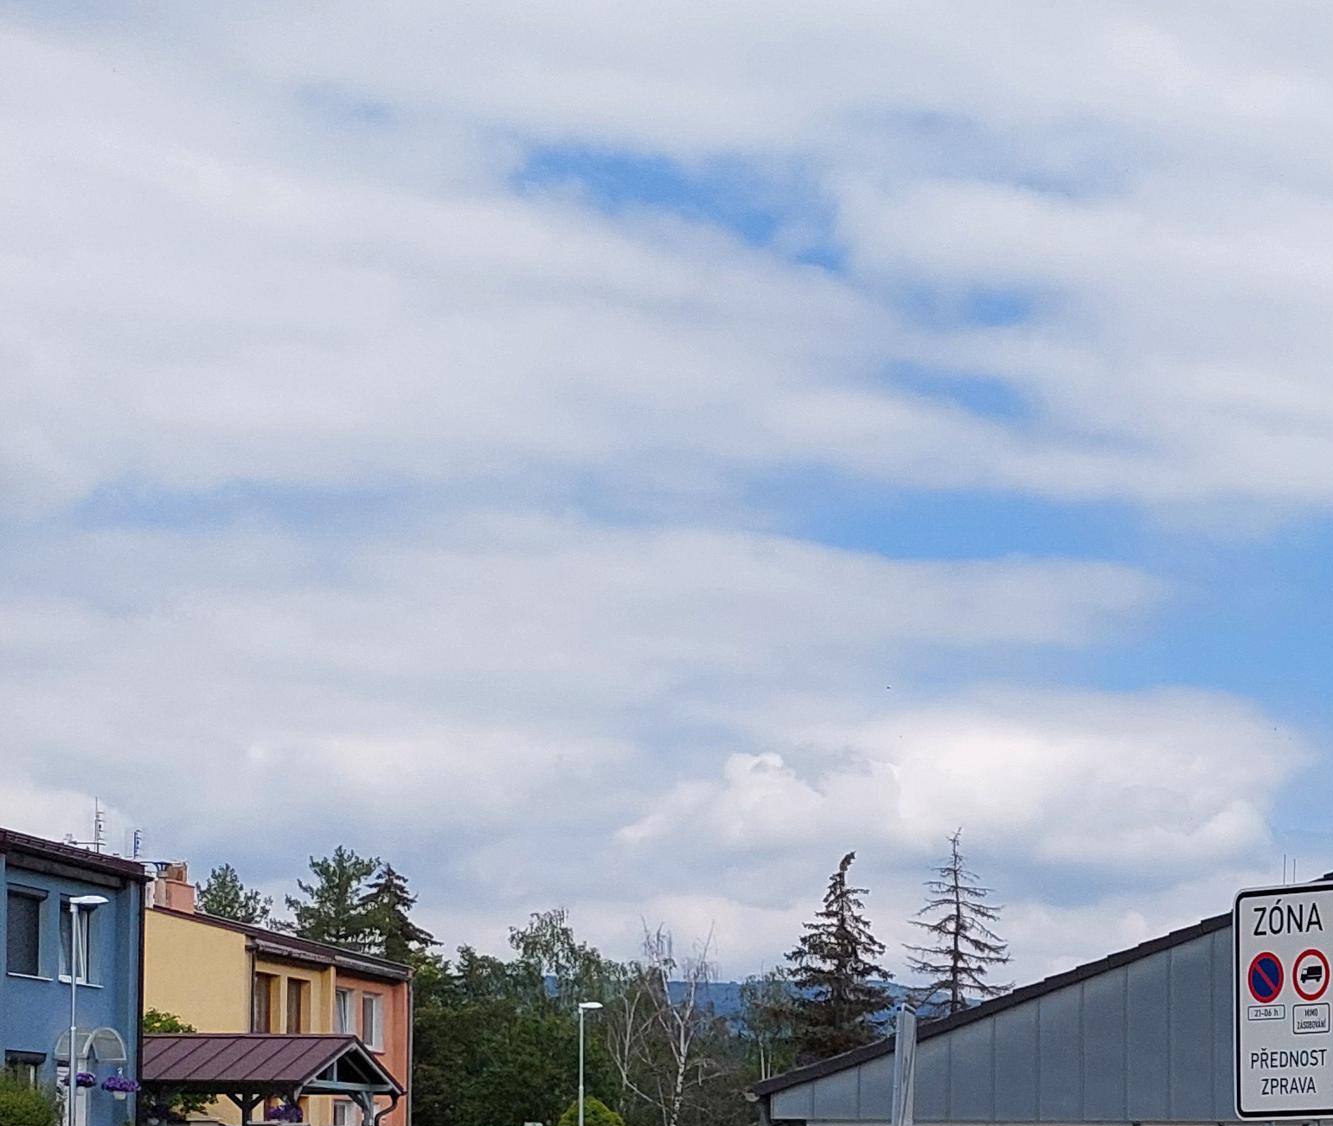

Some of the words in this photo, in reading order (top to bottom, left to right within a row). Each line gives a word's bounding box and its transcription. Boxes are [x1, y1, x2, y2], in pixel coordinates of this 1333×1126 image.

[1253, 899, 1323, 936] ZÓNA
[1251, 1048, 1327, 1069] PŘEDNOST
[1261, 1077, 1317, 1095] ZPRAVA
